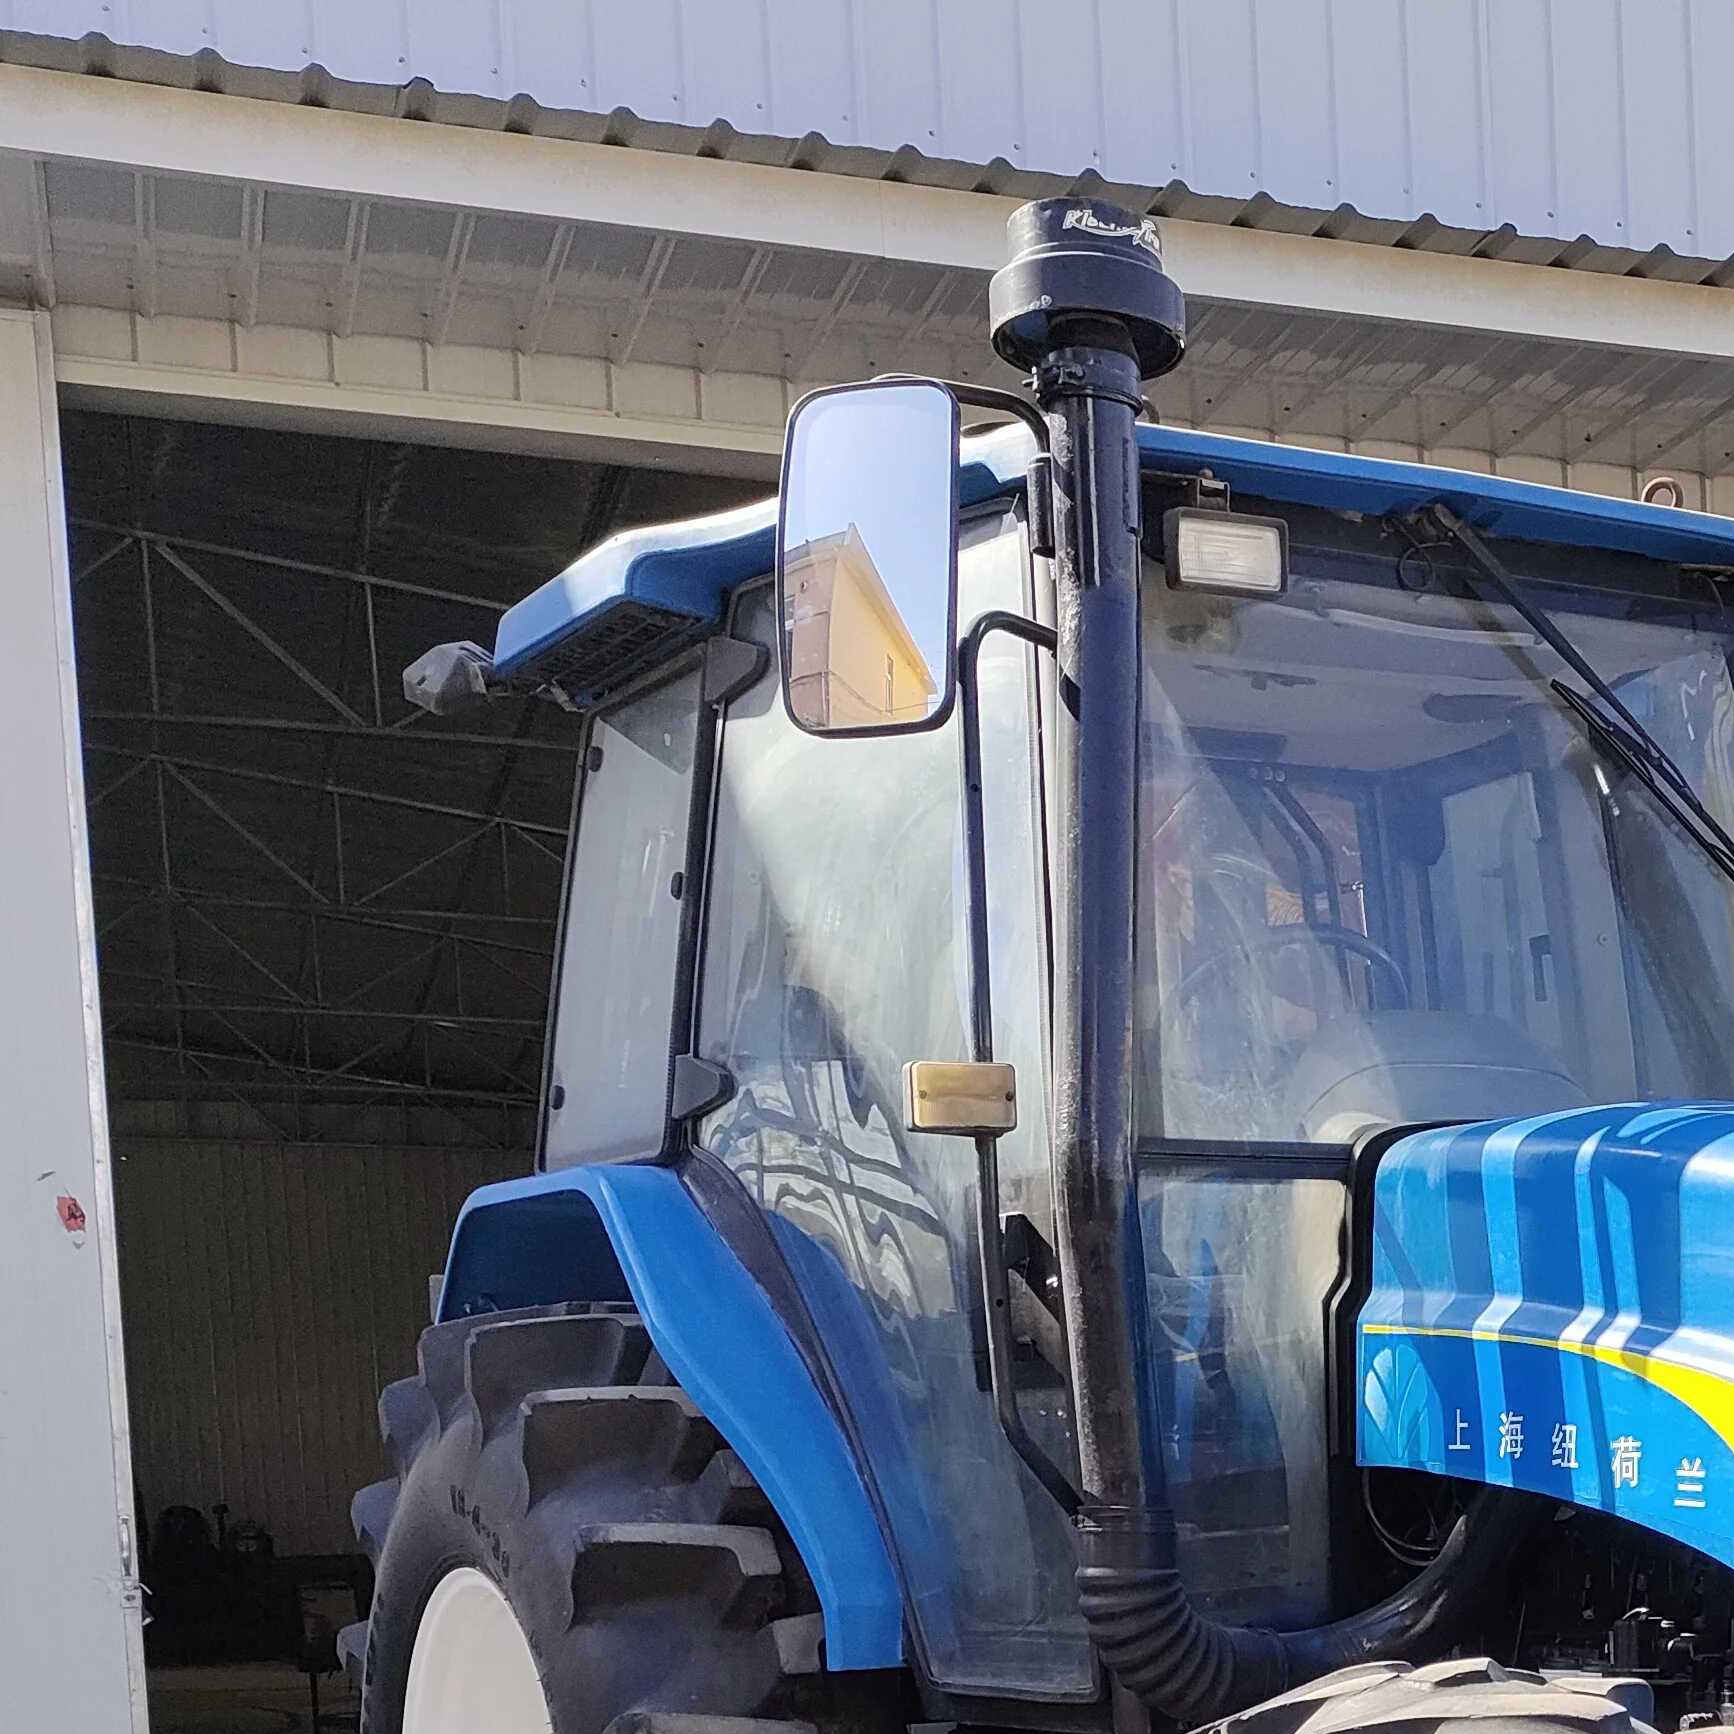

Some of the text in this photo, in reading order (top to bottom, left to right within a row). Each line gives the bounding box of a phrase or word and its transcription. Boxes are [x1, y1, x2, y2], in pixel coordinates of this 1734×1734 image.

[1447, 1408, 1706, 1508] 上海纽荷兰
